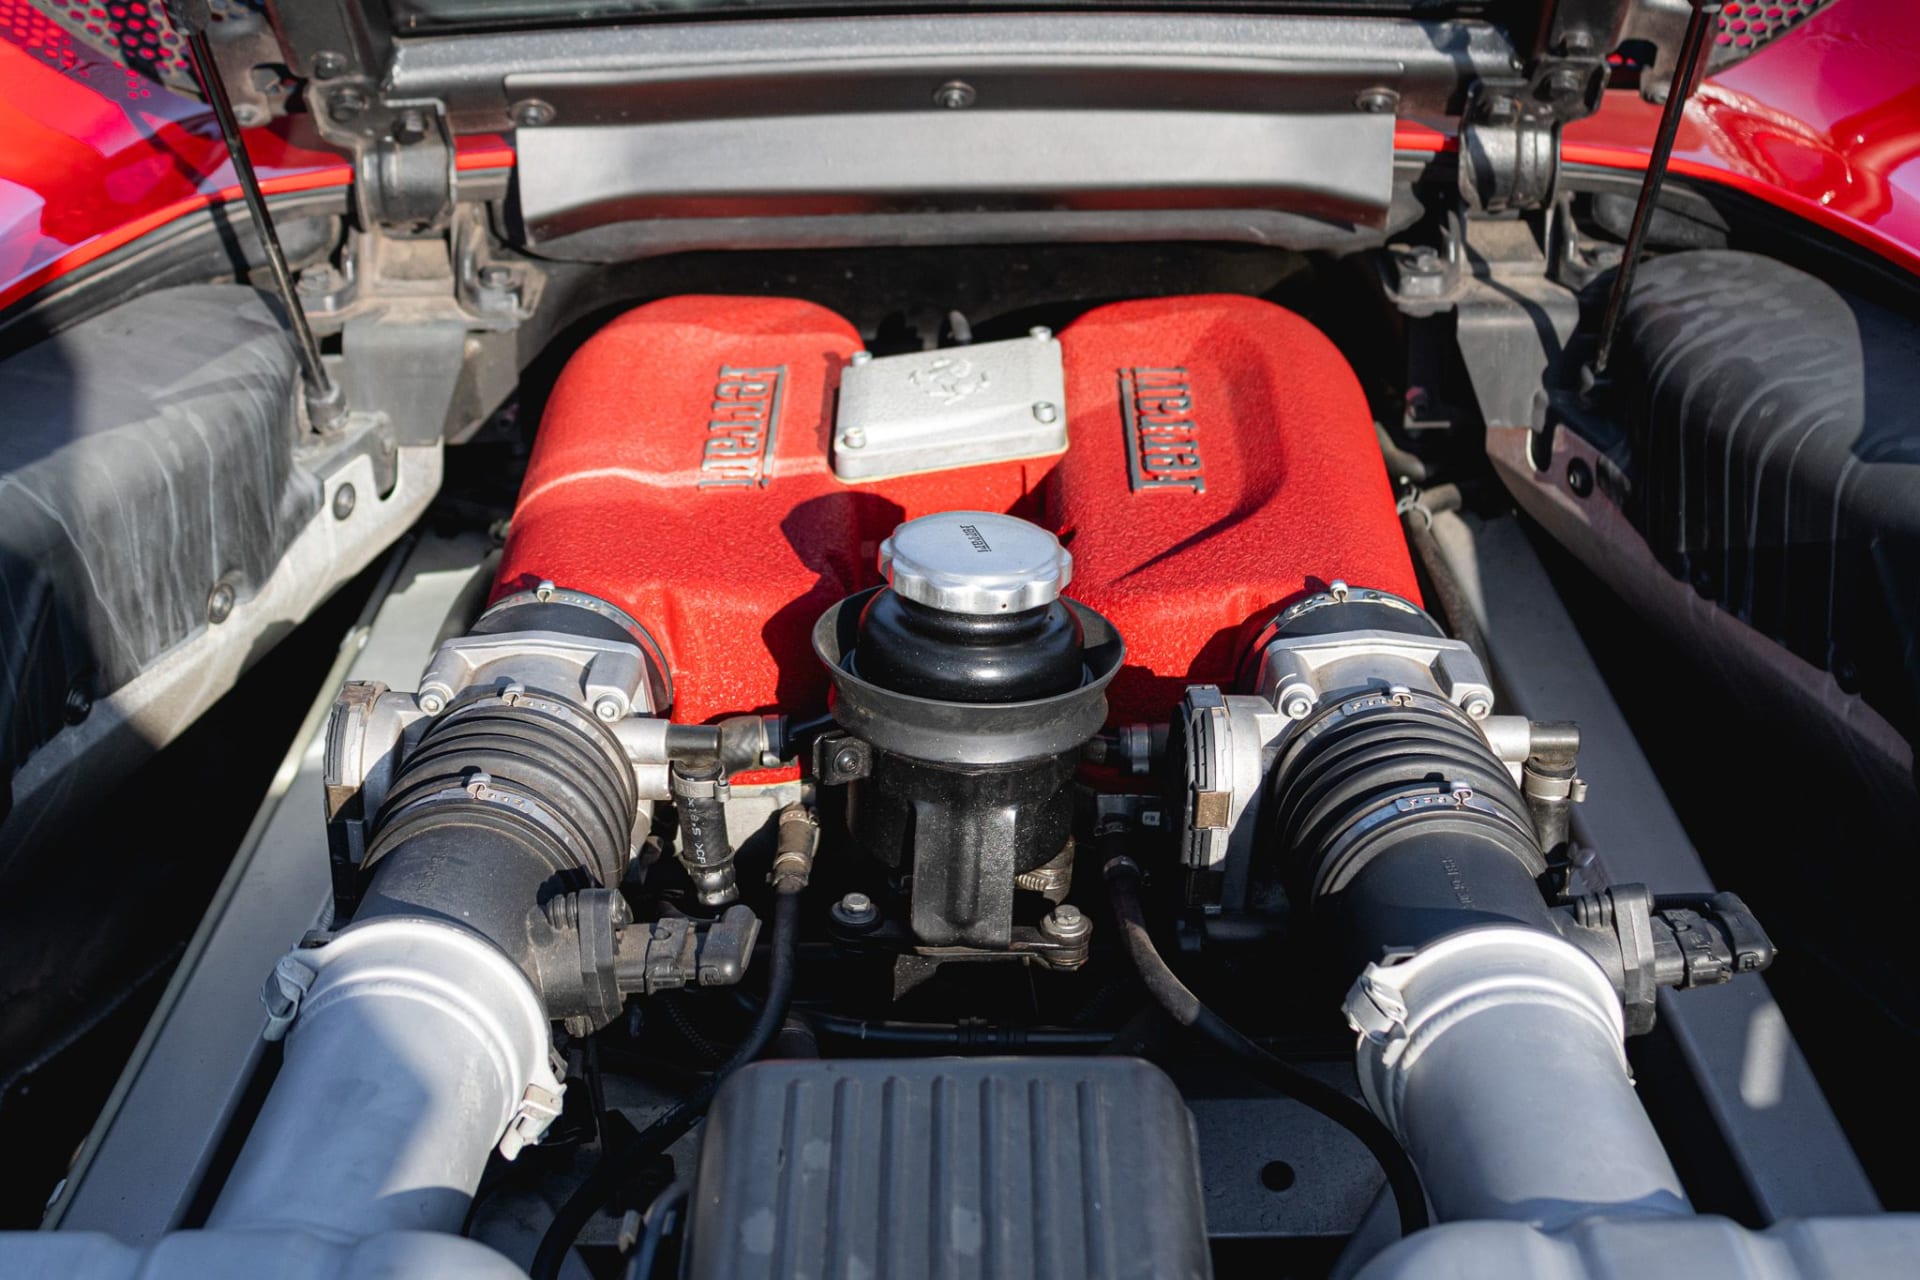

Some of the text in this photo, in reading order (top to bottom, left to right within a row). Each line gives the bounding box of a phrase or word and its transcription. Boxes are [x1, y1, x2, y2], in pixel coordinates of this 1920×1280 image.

[698, 364, 787, 489] Ferrari
[1118, 366, 1205, 493] Ferrari
[959, 524, 993, 553] Ferrari
